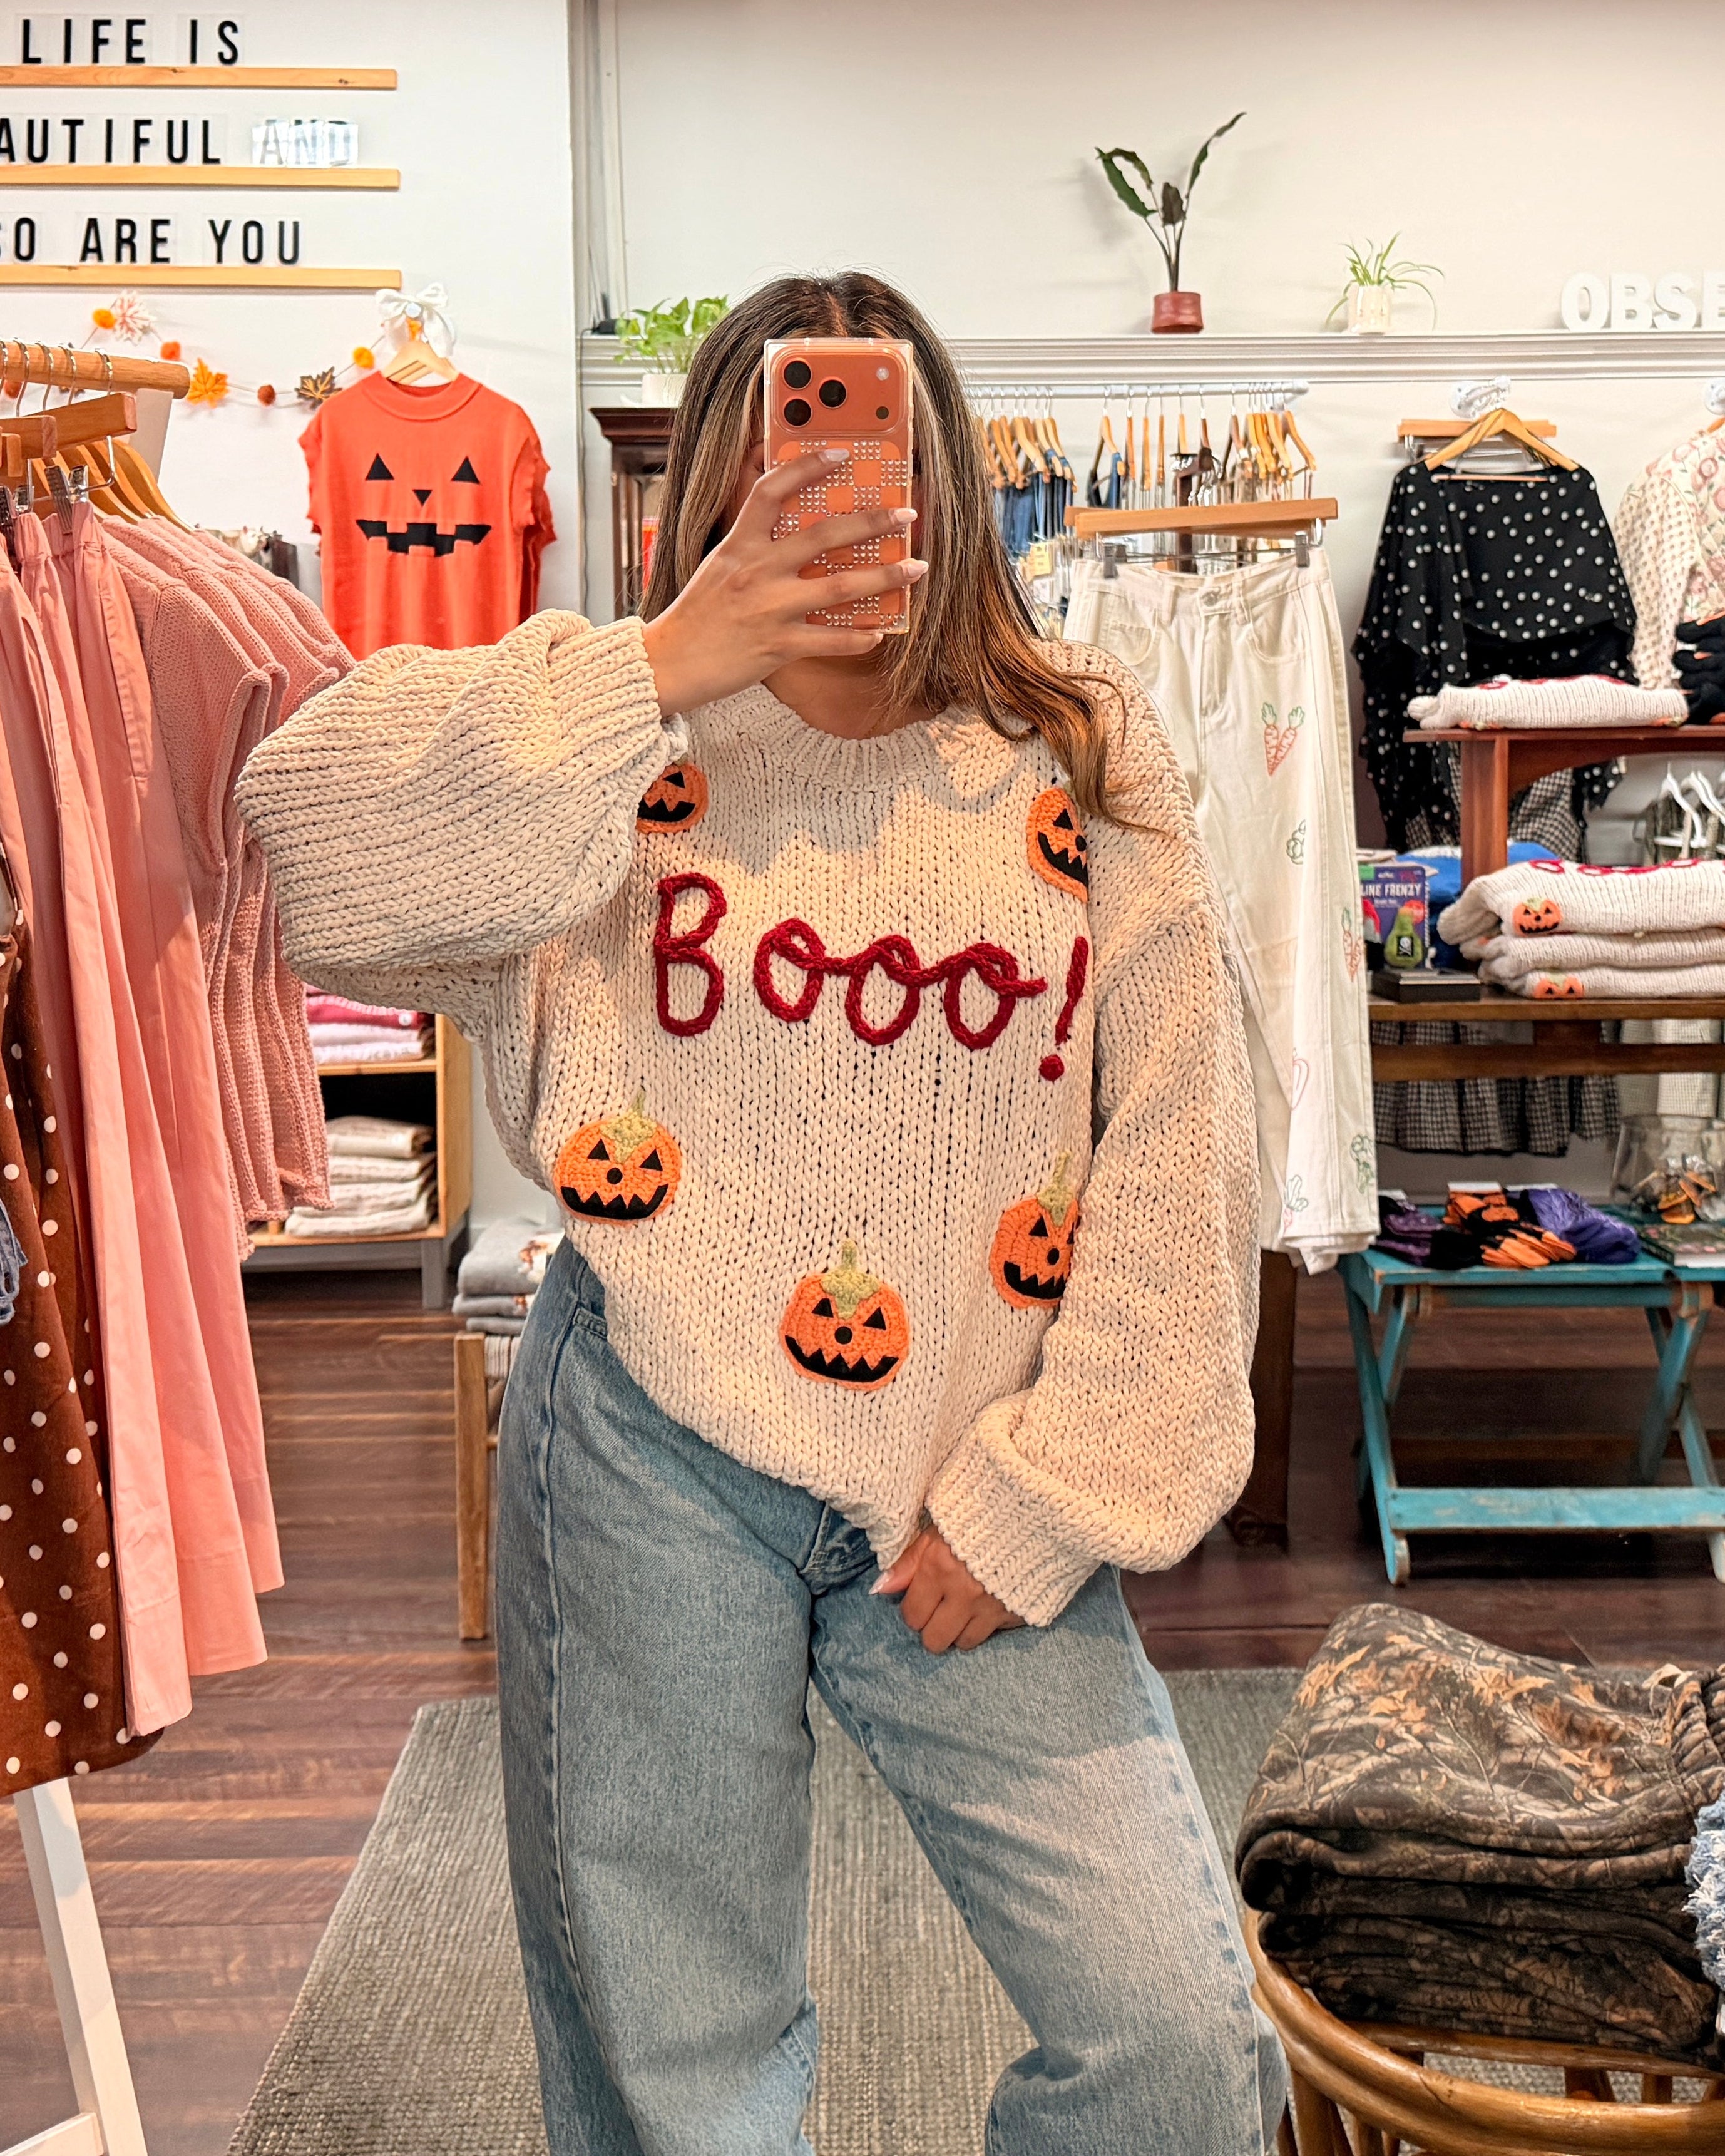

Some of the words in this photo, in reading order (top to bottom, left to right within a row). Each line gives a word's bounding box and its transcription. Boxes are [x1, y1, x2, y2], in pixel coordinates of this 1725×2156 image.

[22, 19, 146, 64] LIFE
[190, 19, 239, 65] IS
[0, 118, 221, 164] AUTIFUL
[0, 217, 36, 262] O
[79, 217, 171, 264] ARE
[208, 219, 300, 265] YOU
[1385, 883, 1422, 898] FRENZY
[653, 871, 1089, 1082] Booo!
